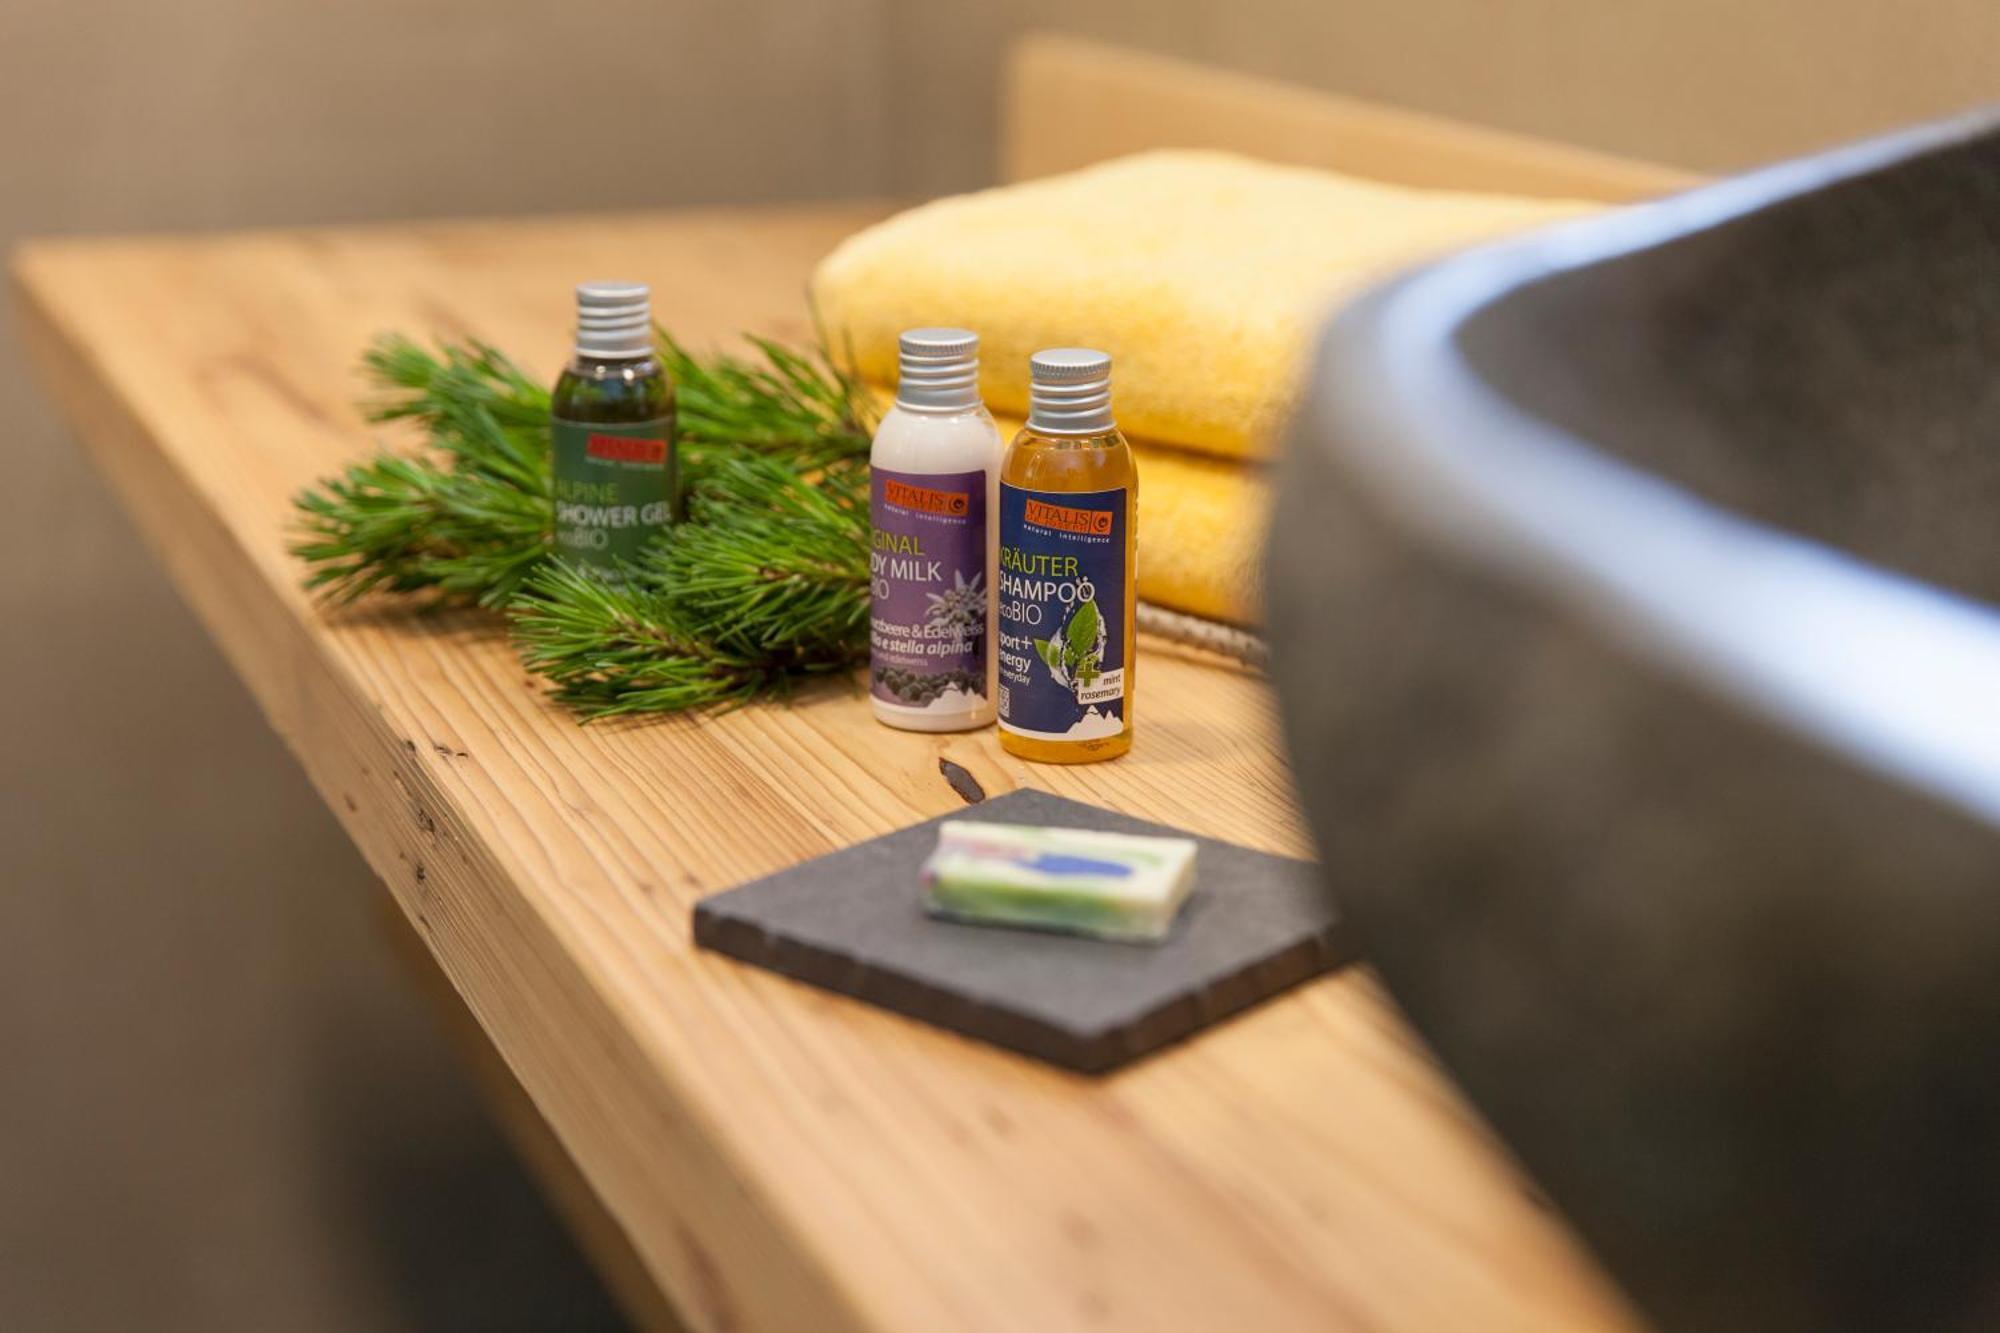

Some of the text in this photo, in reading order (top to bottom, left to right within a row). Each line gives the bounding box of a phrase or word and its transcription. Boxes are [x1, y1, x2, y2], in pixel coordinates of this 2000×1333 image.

[1027, 501, 1090, 526] VITALIS
[871, 529, 926, 556] GINAL
[1023, 523, 1111, 545] natural intelligence
[871, 551, 943, 582] DY MILK
[889, 640, 925, 655] stella
[927, 640, 974, 658] alpina
[1103, 673, 1121, 686] mint
[1080, 685, 1121, 701] rosemary
